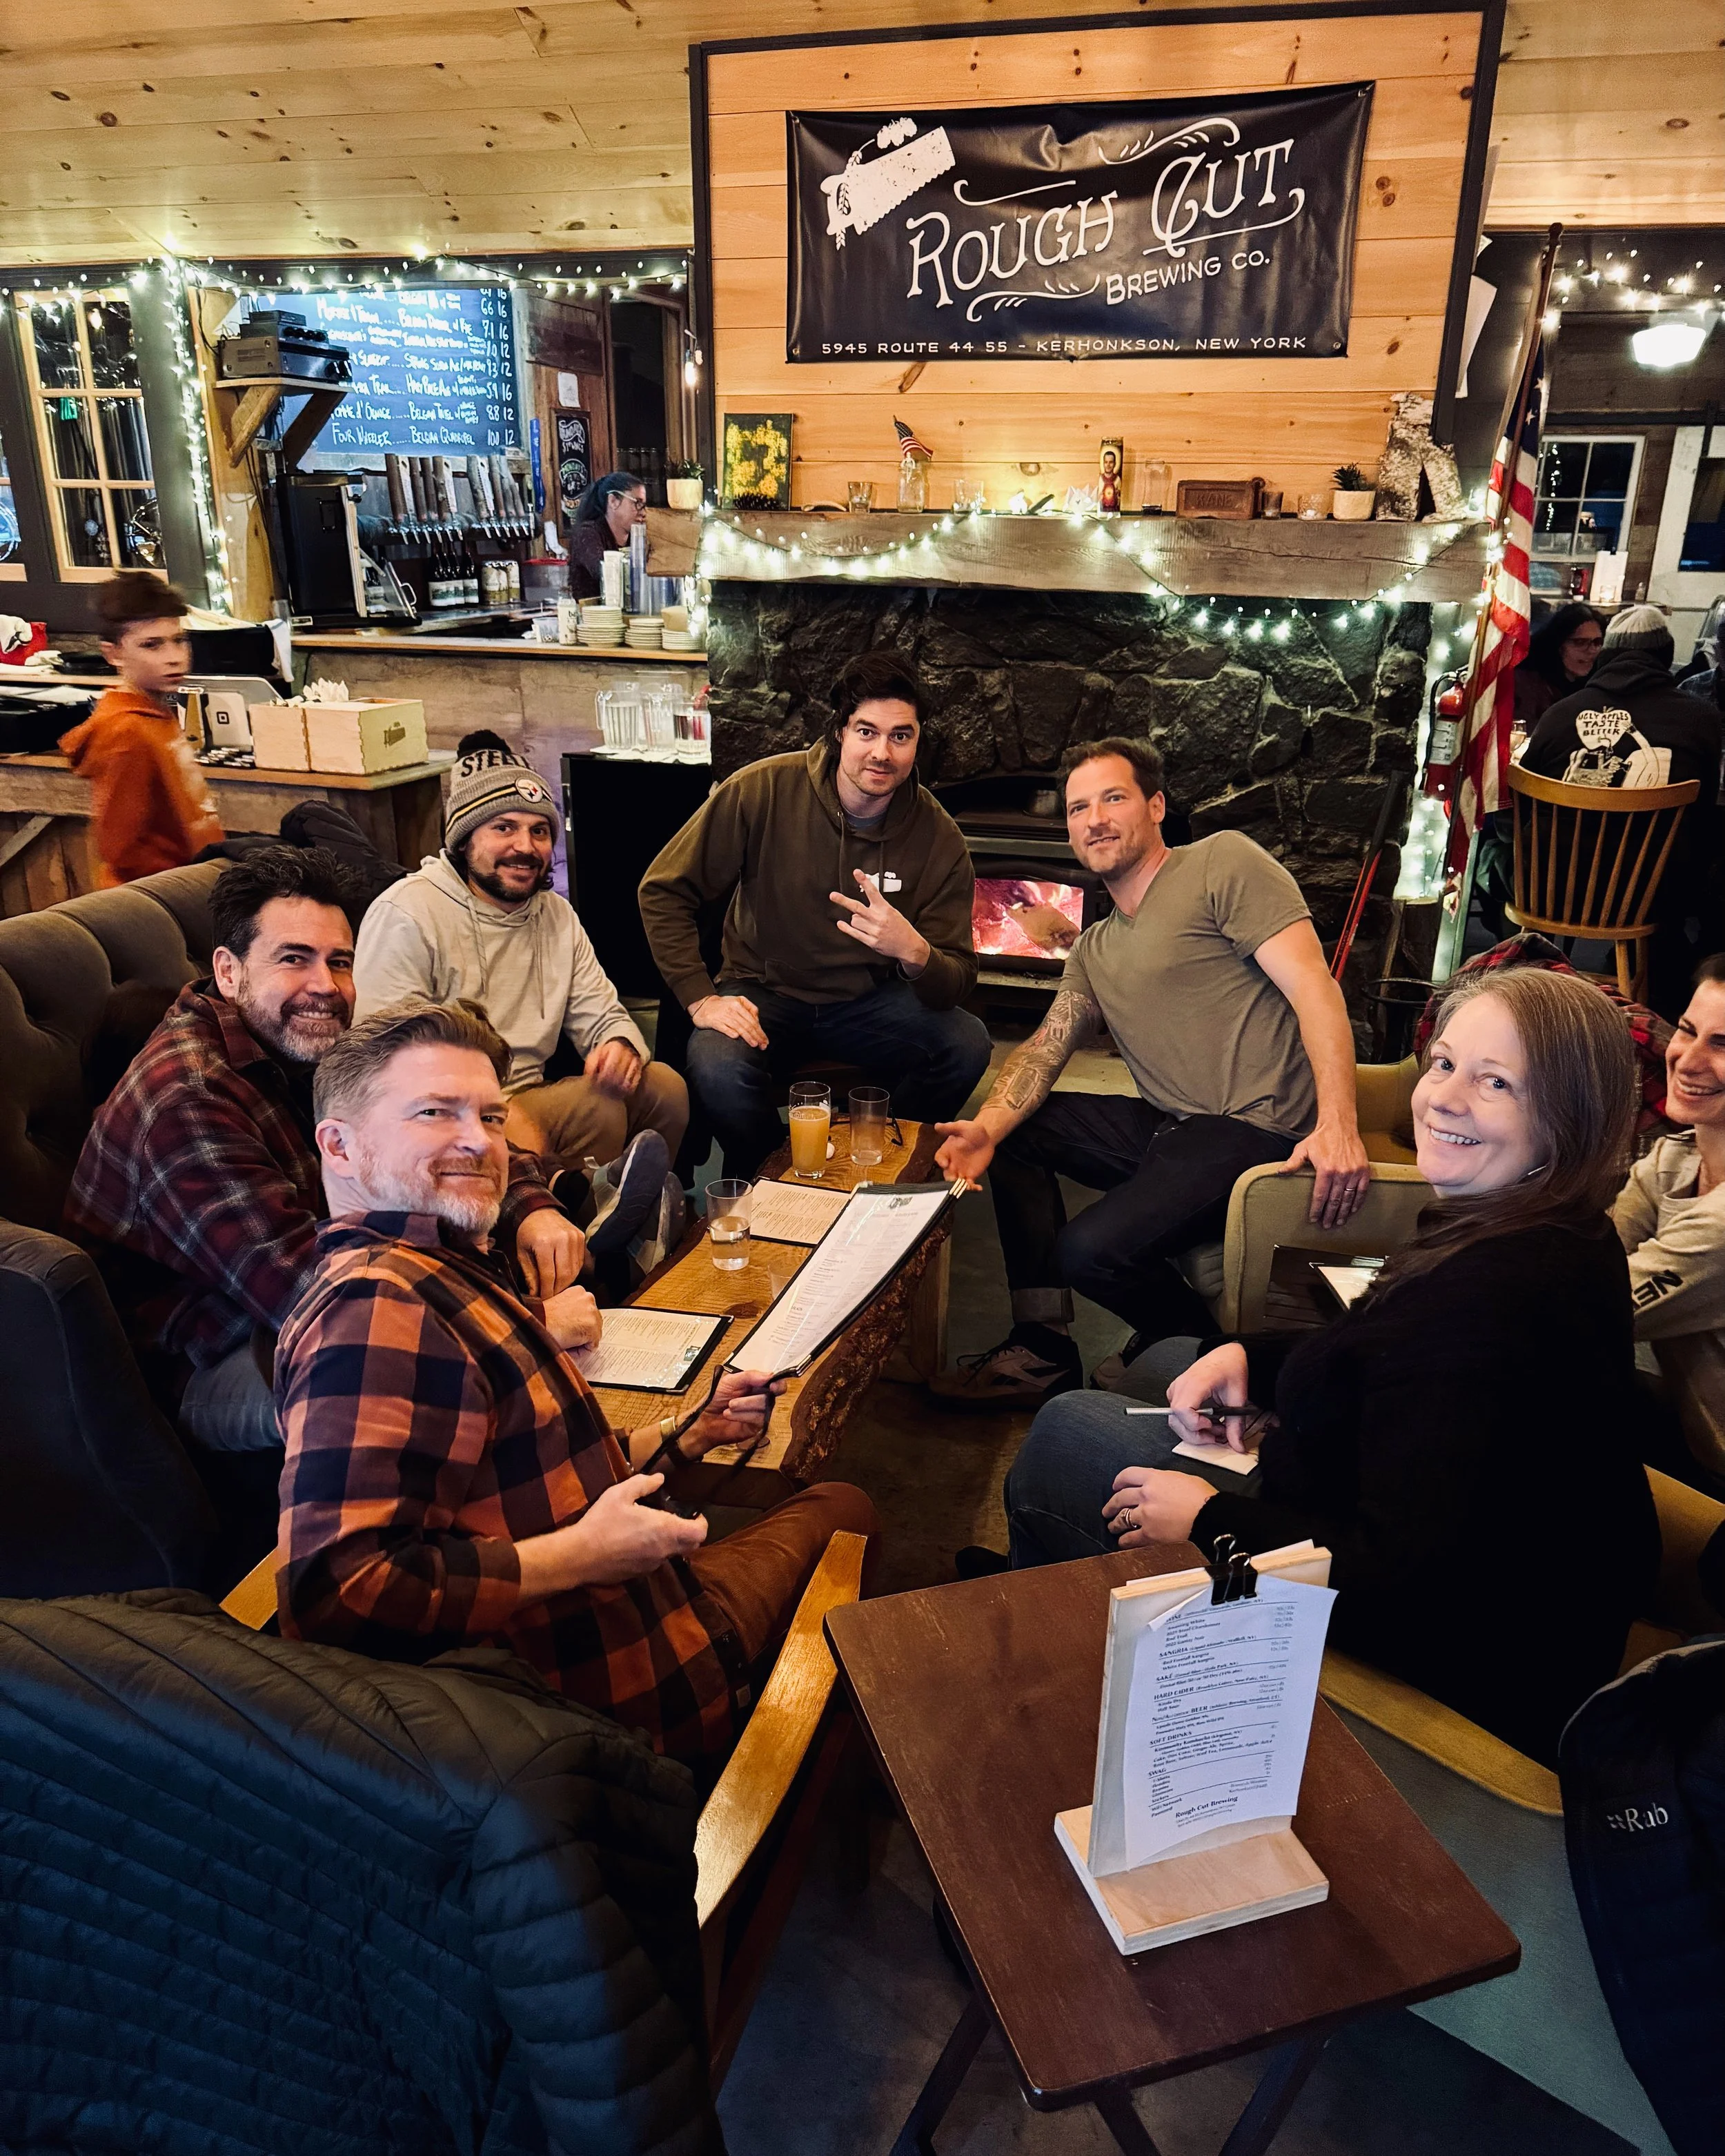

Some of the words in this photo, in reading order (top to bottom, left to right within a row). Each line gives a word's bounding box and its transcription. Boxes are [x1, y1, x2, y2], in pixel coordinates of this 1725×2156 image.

[905, 190, 1118, 308] ROUGH
[1150, 139, 1295, 257] CUT
[1105, 253, 1222, 306] BREWING
[1230, 250, 1270, 271] CO.
[497, 300, 507, 318] 16
[499, 322, 509, 340] 16
[500, 342, 511, 359] 12
[821, 342, 867, 354] 5945
[877, 342, 939, 353] ROUTE
[949, 342, 974, 353] 44
[985, 341, 1007, 353] 55
[1036, 339, 1181, 352] KERHONKSON,
[1195, 337, 1240, 350] NEW
[1250, 337, 1307, 349] YORK
[500, 362, 513, 377] 12
[502, 382, 513, 402] 16
[503, 406, 515, 421] 12
[331, 422, 357, 445] FOUR
[504, 428, 515, 446] 12
[1601, 711, 1629, 721] APPLES
[1159, 1646, 1188, 1659] SANGRIA
[1153, 1690, 1173, 1701] HARD
[1174, 1686, 1194, 1697] CIDER
[1190, 1705, 1208, 1714] BEER
[1150, 1736, 1167, 1745] SOFT
[1167, 1730, 1192, 1741] DRINKS
[1148, 1767, 1167, 1777] SWAG
[1175, 1804, 1196, 1819] Rough
[1196, 1802, 1209, 1812] Cut
[1210, 1795, 1239, 1808] Brewing
[1624, 1801, 1669, 1832] Rab
